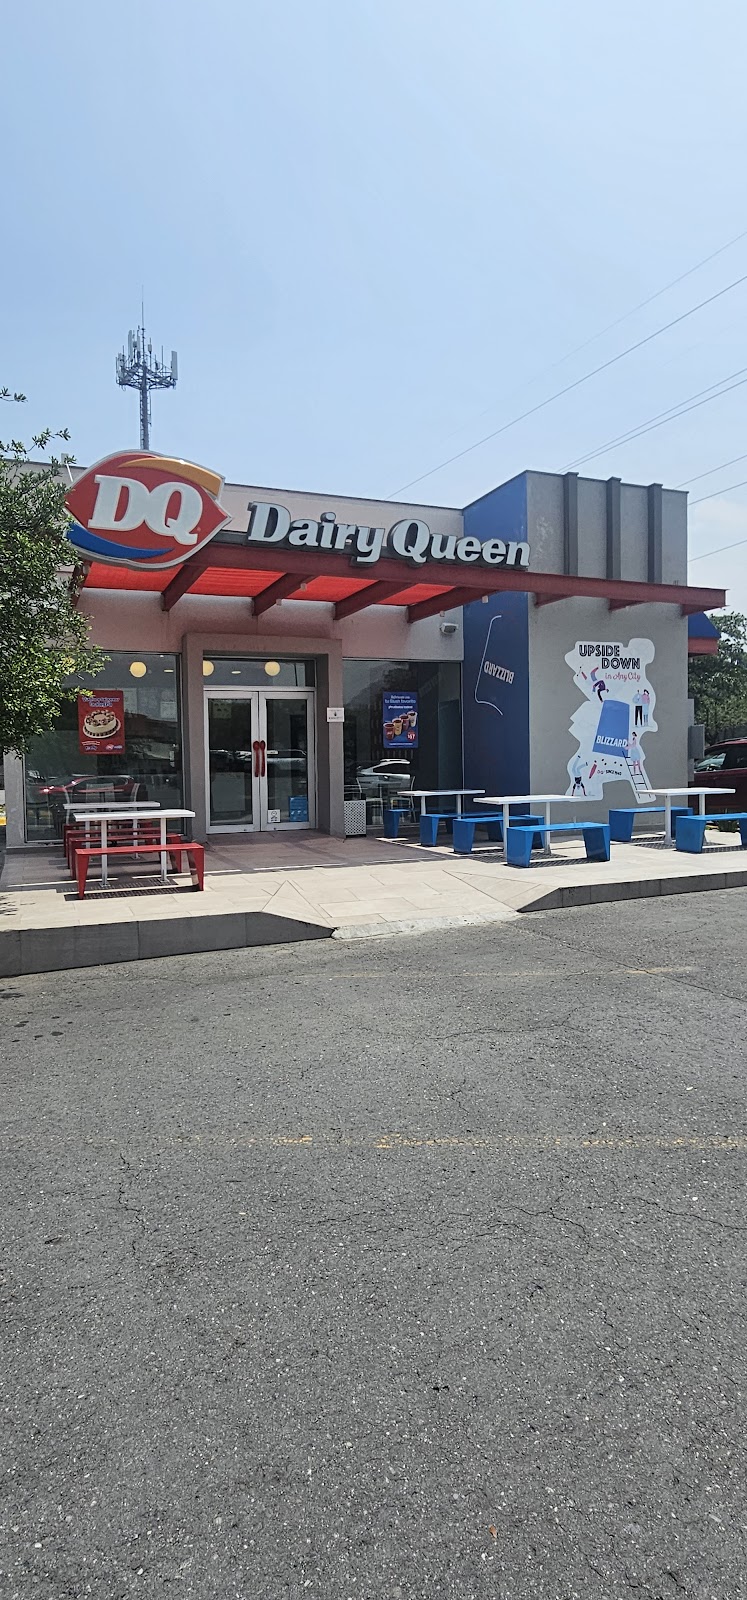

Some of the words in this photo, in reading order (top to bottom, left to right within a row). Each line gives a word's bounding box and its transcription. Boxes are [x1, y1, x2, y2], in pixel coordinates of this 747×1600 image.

[88, 475, 203, 545] DQ
[246, 501, 385, 563] Dairy
[390, 519, 530, 567] Queen
[578, 644, 620, 657] UPSIDE
[601, 657, 641, 670] DOWN
[484, 661, 515, 685] BLIZZARD
[604, 672, 612, 680] in
[596, 735, 628, 747] BLIZZARD
